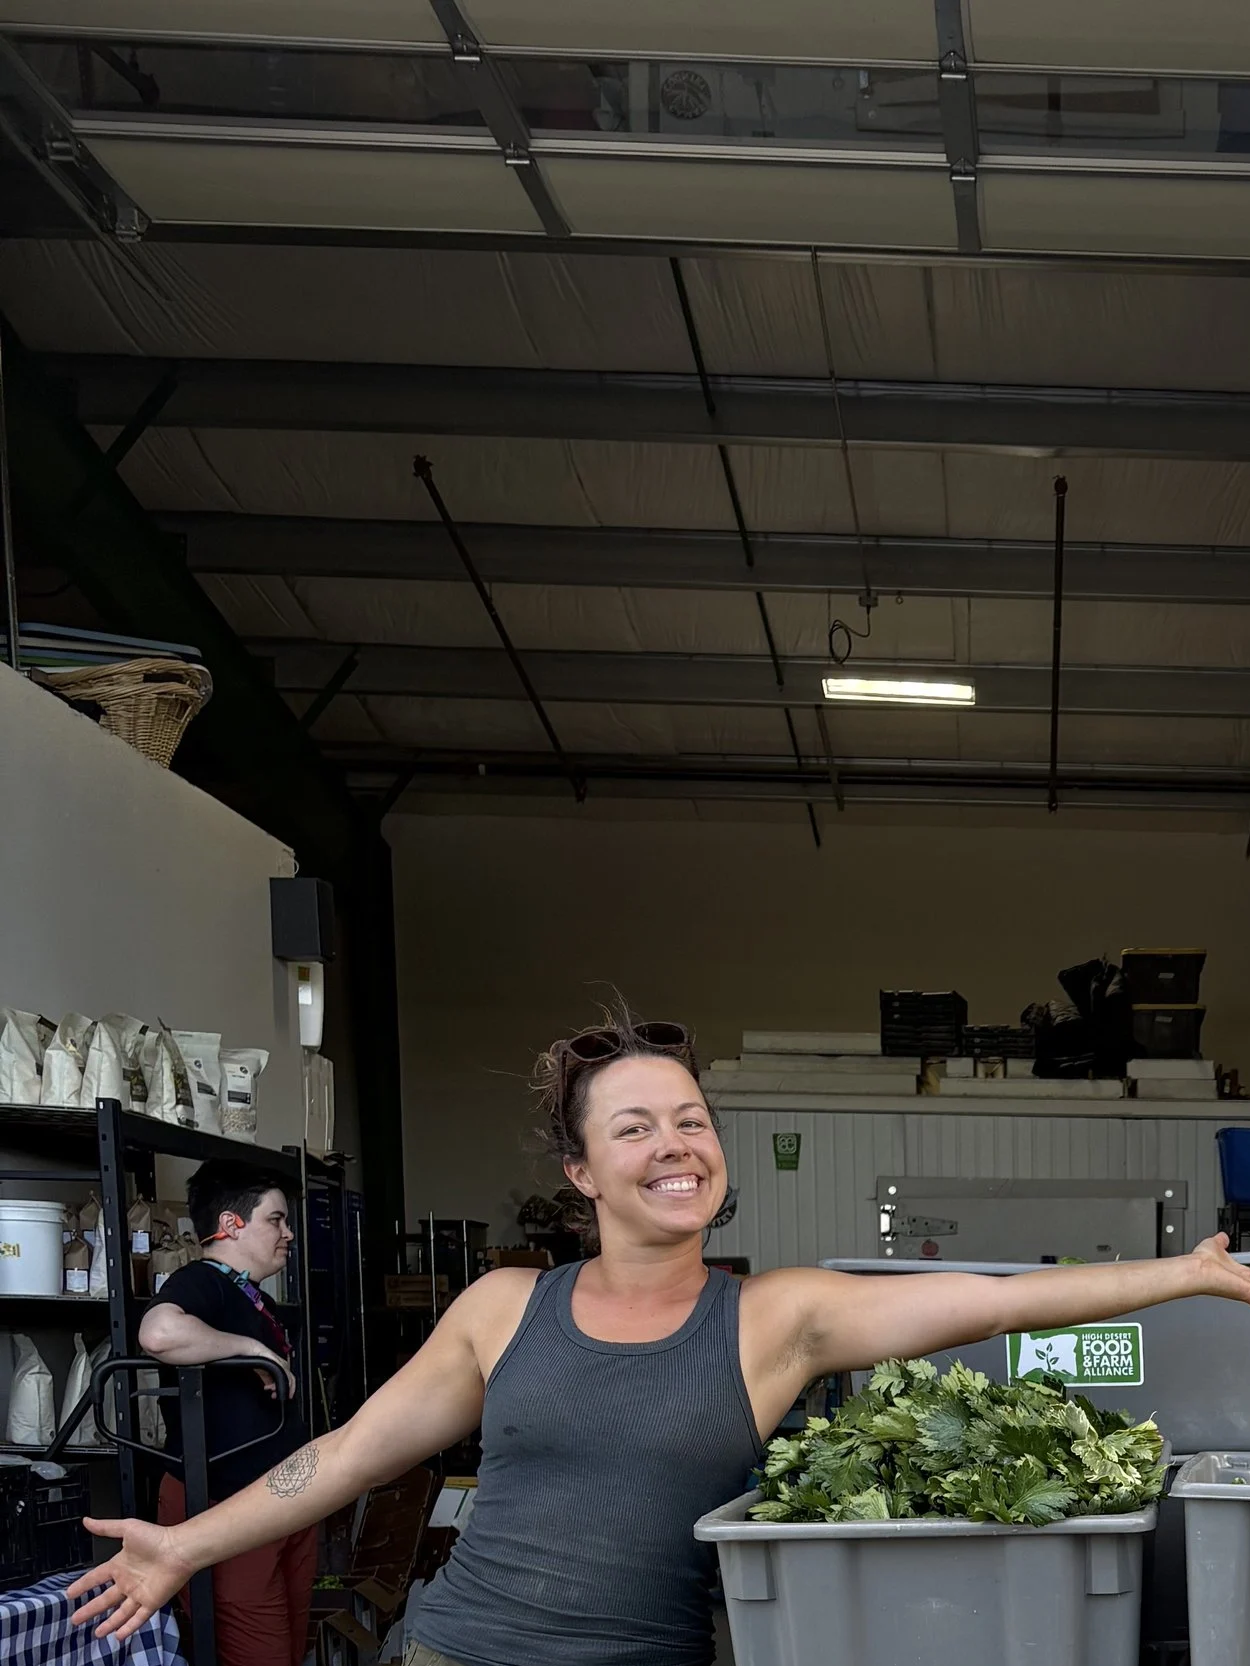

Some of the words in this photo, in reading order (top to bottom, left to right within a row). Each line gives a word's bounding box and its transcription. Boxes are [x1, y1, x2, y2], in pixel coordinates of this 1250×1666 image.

[1104, 1332, 1132, 1340] DESERT
[1082, 1340, 1133, 1355] FOOD
[1083, 1367, 1134, 1376] ALLIANCE
